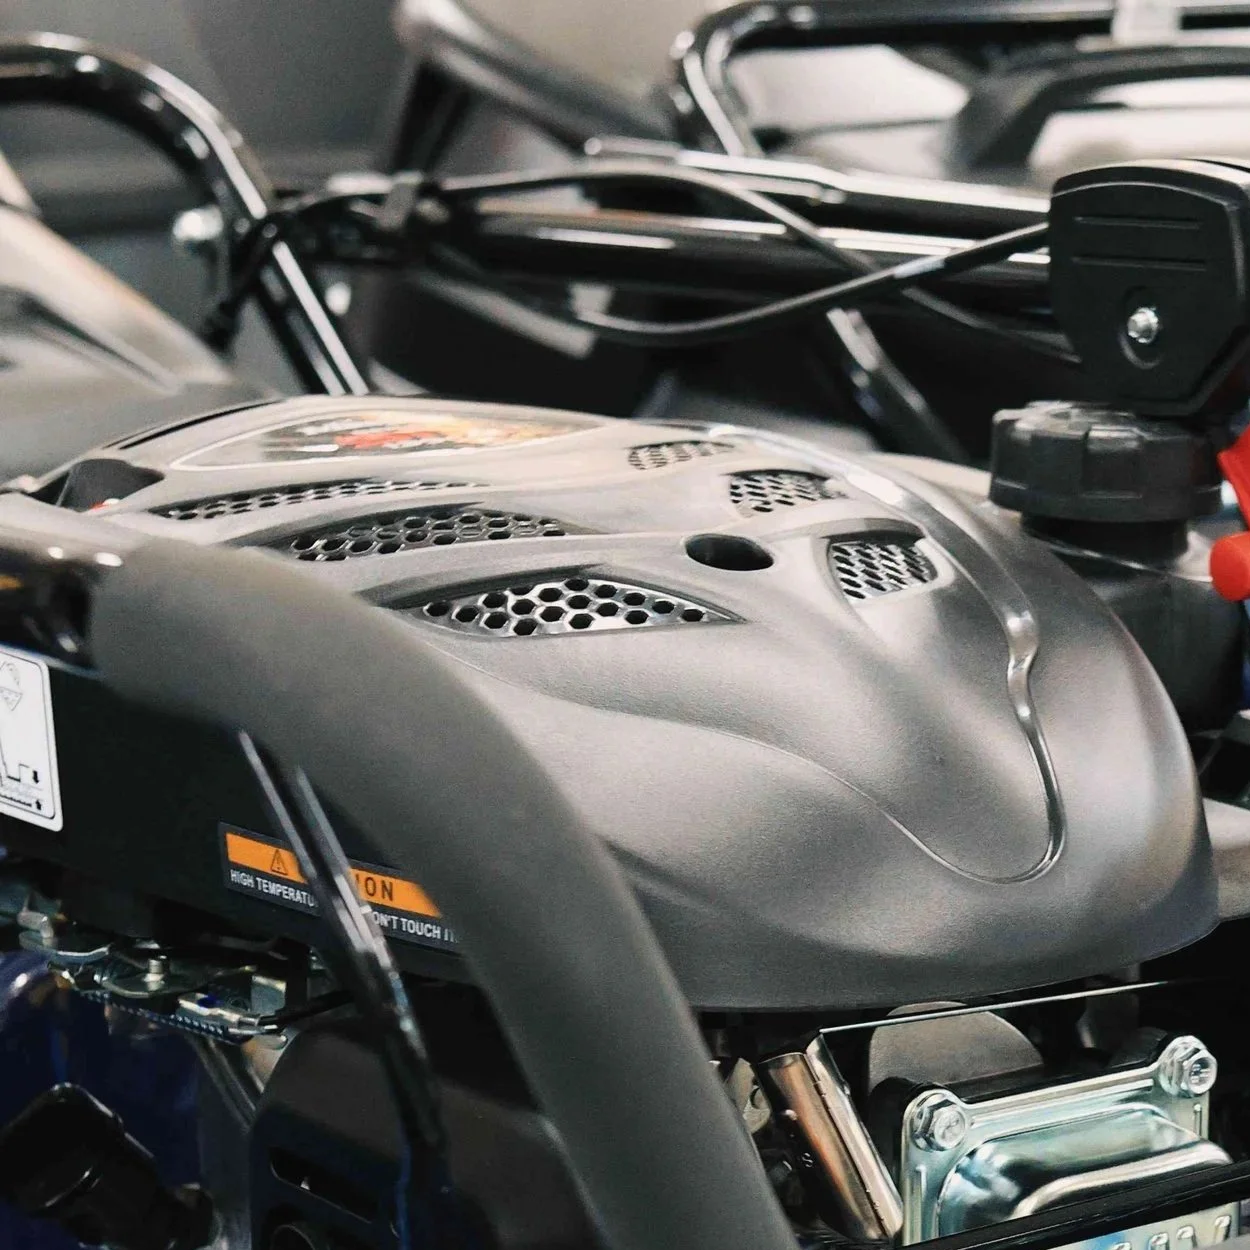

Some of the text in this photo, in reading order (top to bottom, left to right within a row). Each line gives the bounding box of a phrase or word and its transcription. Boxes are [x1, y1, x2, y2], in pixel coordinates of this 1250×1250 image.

[230, 869, 254, 888] HIGH
[256, 877, 319, 908] TEMPERATU
[371, 911, 399, 930] ON'T
[400, 917, 441, 939] TOUCH
